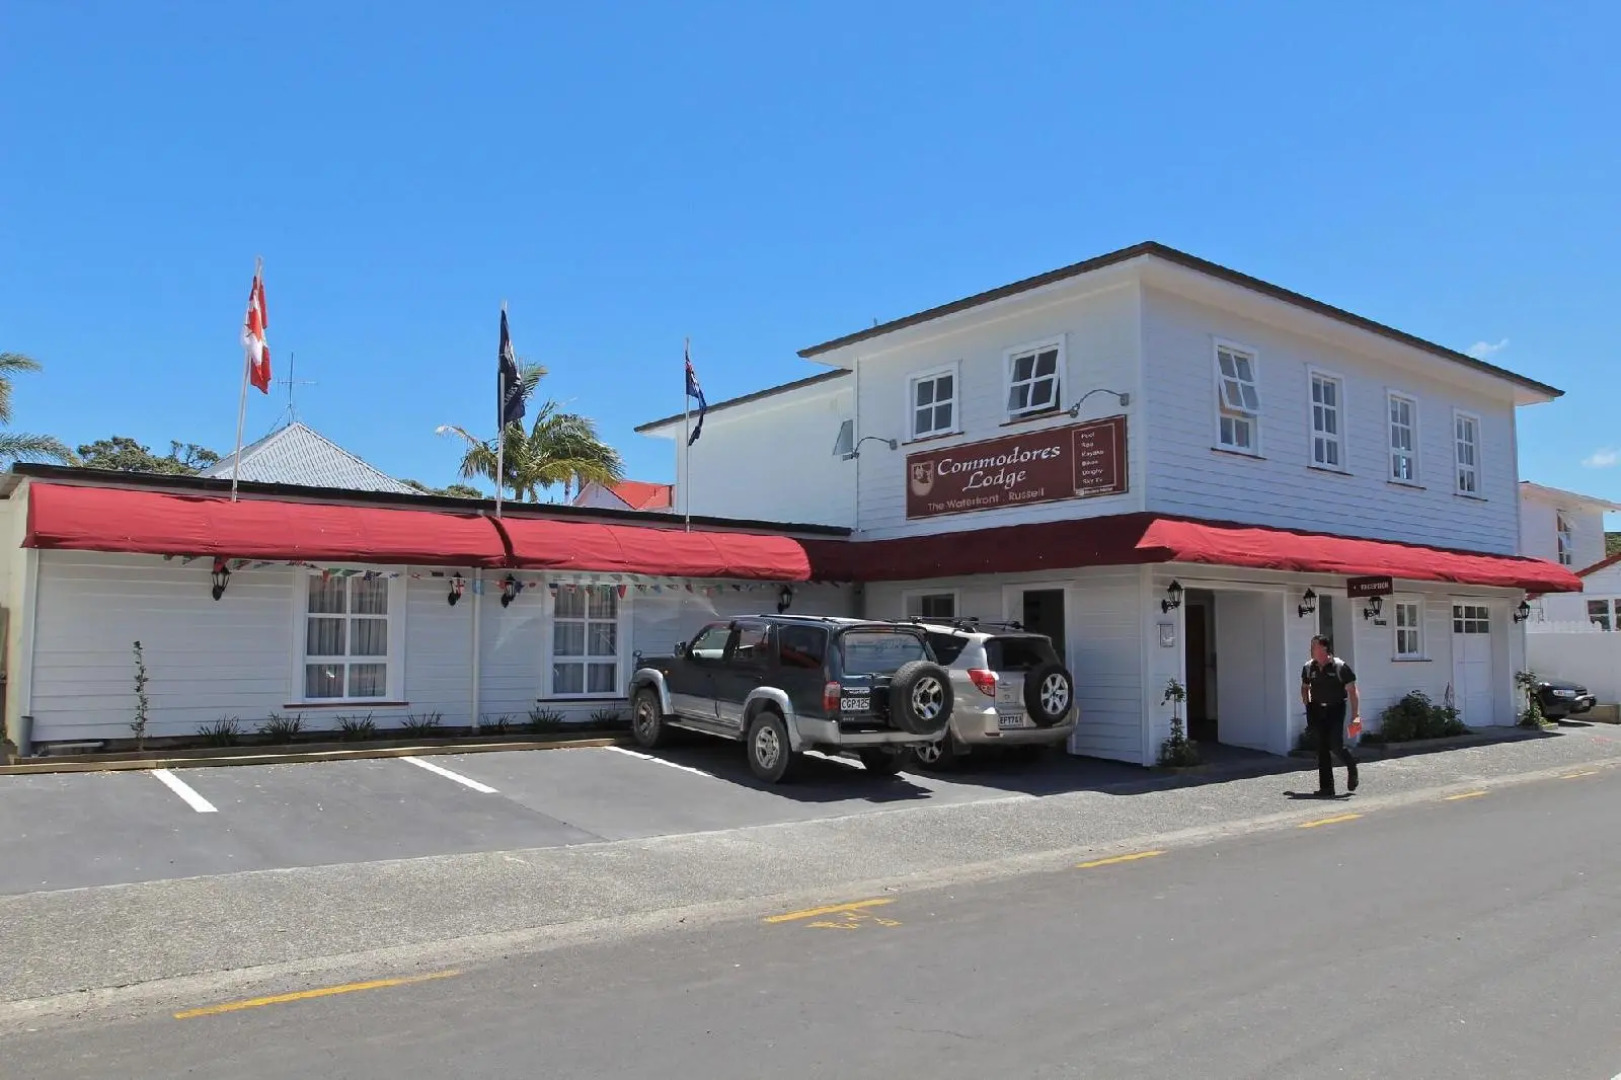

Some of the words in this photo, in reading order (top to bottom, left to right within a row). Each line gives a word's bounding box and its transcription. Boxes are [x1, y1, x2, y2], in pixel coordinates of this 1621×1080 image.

[937, 445, 1061, 477] Commodores
[962, 468, 1027, 492] Lodge
[928, 501, 945, 512] The
[946, 493, 1000, 511] Waterfront
[1008, 487, 1045, 502] Russell
